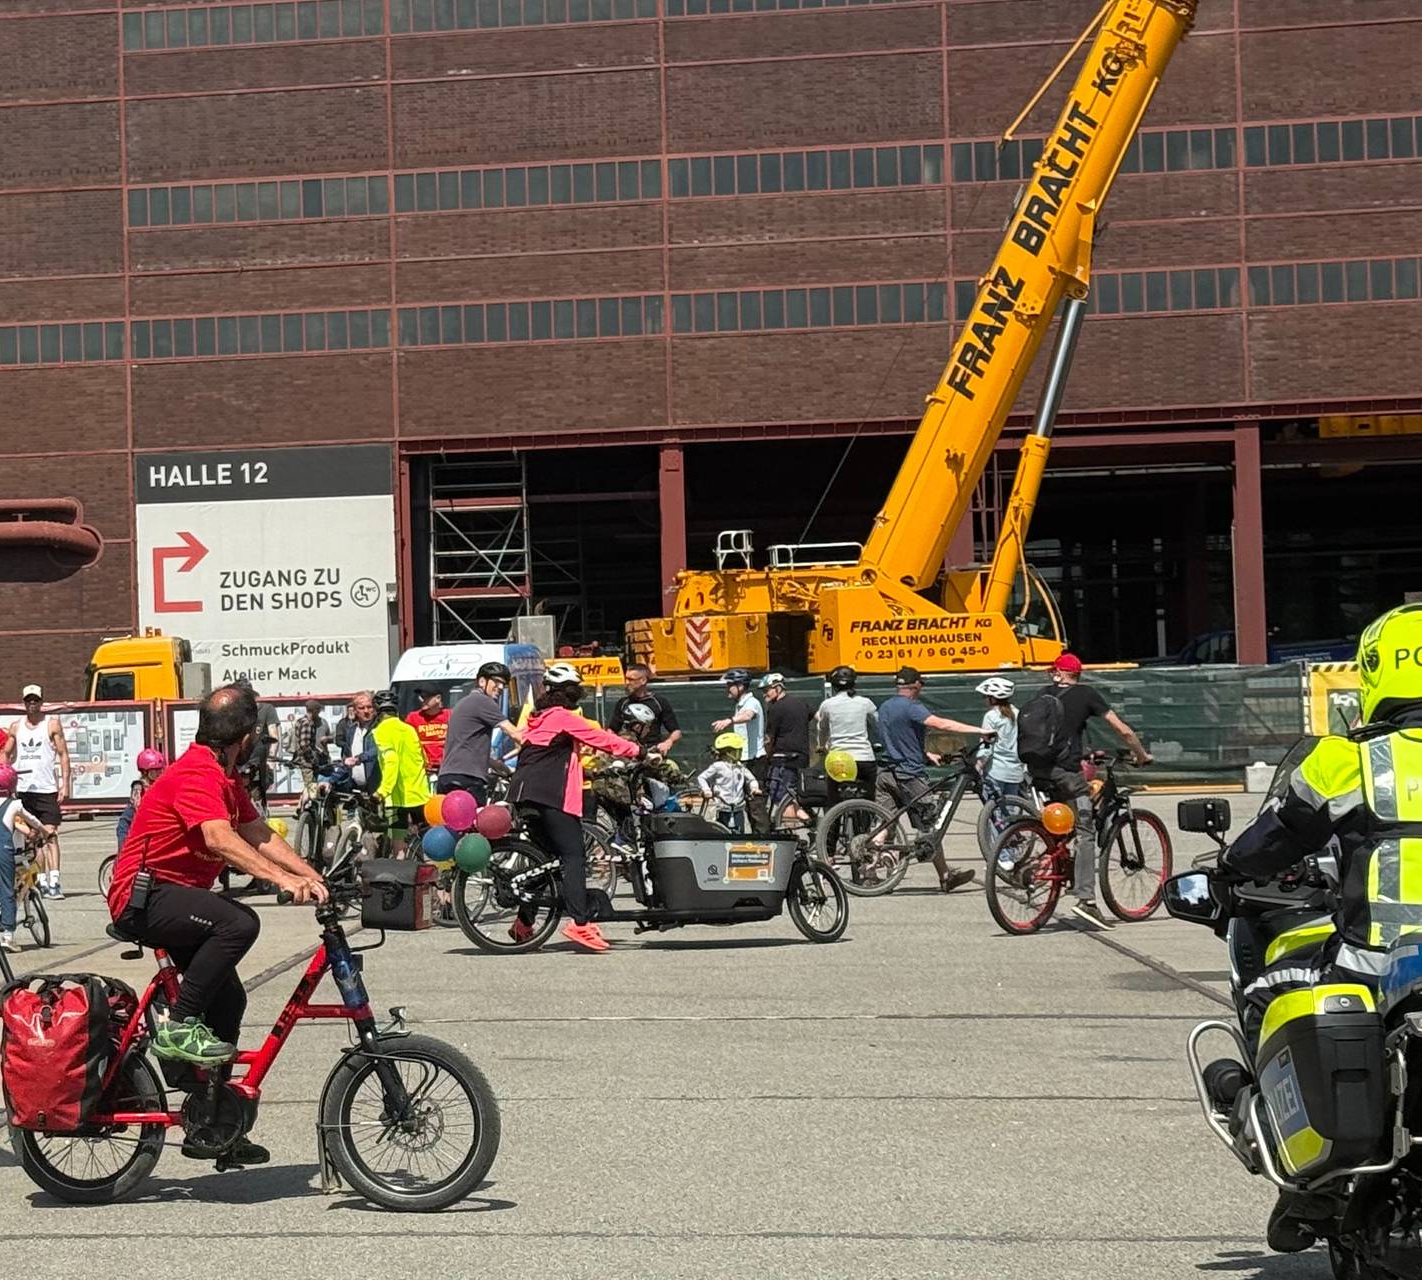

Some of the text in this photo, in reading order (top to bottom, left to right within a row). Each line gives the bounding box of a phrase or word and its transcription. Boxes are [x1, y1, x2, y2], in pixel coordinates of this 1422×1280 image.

[946, 264, 1026, 401] FRANZ
[1012, 99, 1099, 258] BRACHT
[149, 461, 268, 488] HALLE 12
[219, 568, 341, 589] ZUGANG ZU
[220, 590, 343, 612] DEN SHOPS
[849, 616, 993, 633] FRANZ BRACHT KG
[861, 632, 982, 646] RECKLINGHAUSEN
[221, 641, 351, 657] SchmuckProdukt
[865, 650, 873, 660] 0
[877, 649, 893, 659] 23
[897, 648, 912, 658] 61
[927, 648, 935, 657] 9
[939, 647, 956, 656] 60
[960, 645, 990, 656] 45-0
[222, 666, 318, 682] Atelier Mack
[607, 665, 620, 674] KG
